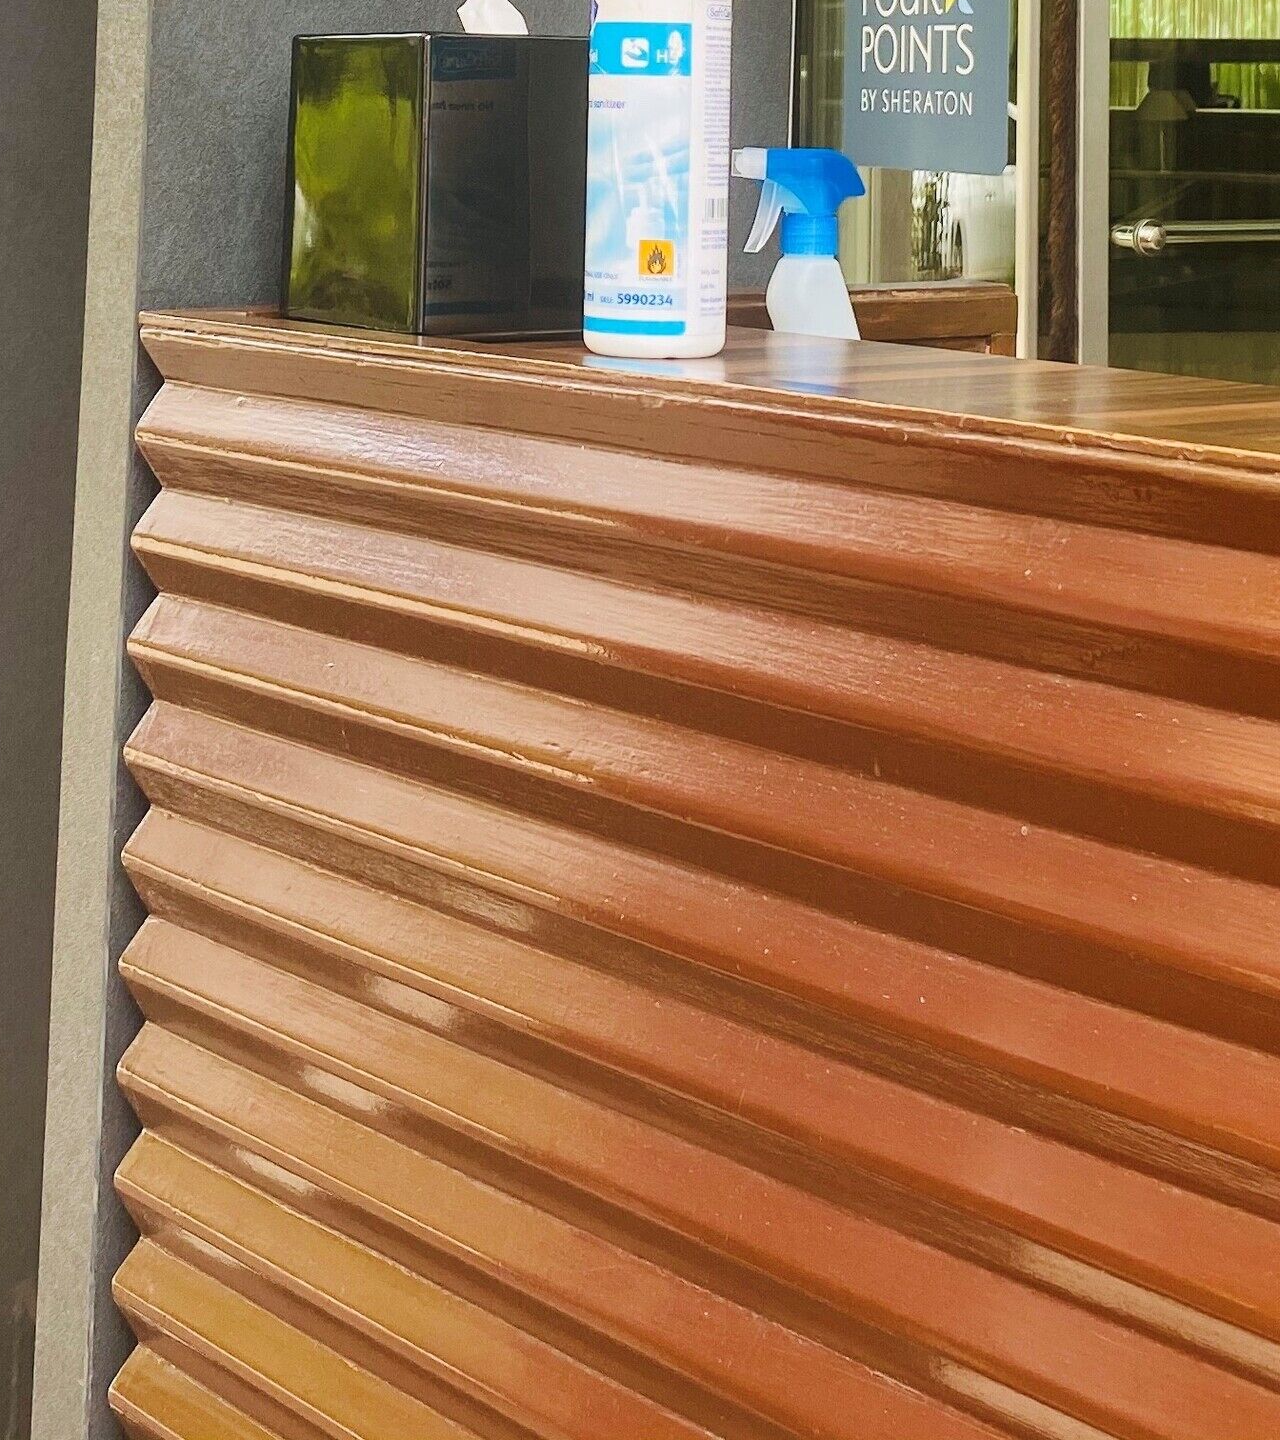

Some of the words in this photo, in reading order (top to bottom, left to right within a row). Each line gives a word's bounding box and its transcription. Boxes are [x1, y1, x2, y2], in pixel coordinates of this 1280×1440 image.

[861, 23, 974, 76] POINTS
[860, 88, 878, 112] BY
[882, 89, 974, 116] SHERATON
[617, 293, 673, 306] 5990234
